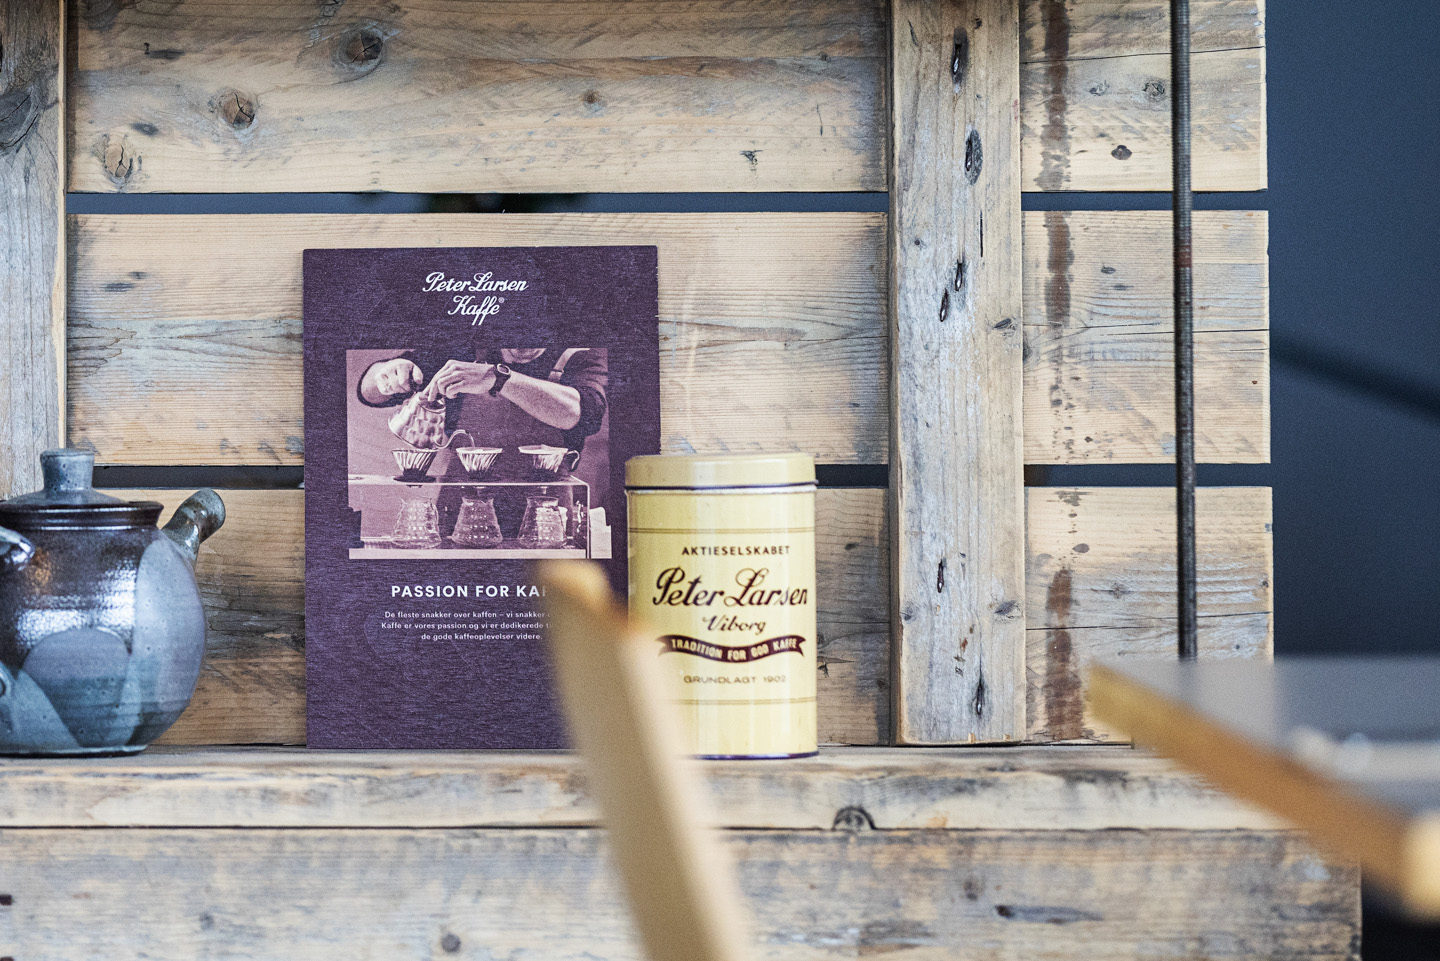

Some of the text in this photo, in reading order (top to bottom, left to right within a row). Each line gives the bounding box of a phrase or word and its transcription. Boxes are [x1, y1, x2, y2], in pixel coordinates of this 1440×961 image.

[421, 271, 530, 292] Peter Larsen
[681, 544, 791, 556] AKTIESELSKABET
[391, 585, 468, 598] PASSION
[475, 585, 509, 598] FOR
[652, 564, 808, 607] Peter Larsen
[437, 622, 467, 630] passion
[701, 615, 767, 636] Viborg
[433, 633, 453, 641] gode
[454, 633, 513, 641] kaffeoplevelser
[671, 638, 723, 659] TRADITION
[727, 649, 747, 661] FOR
[772, 637, 798, 652] KAFFE
[683, 674, 786, 684] GRUNDLAGT 1902
